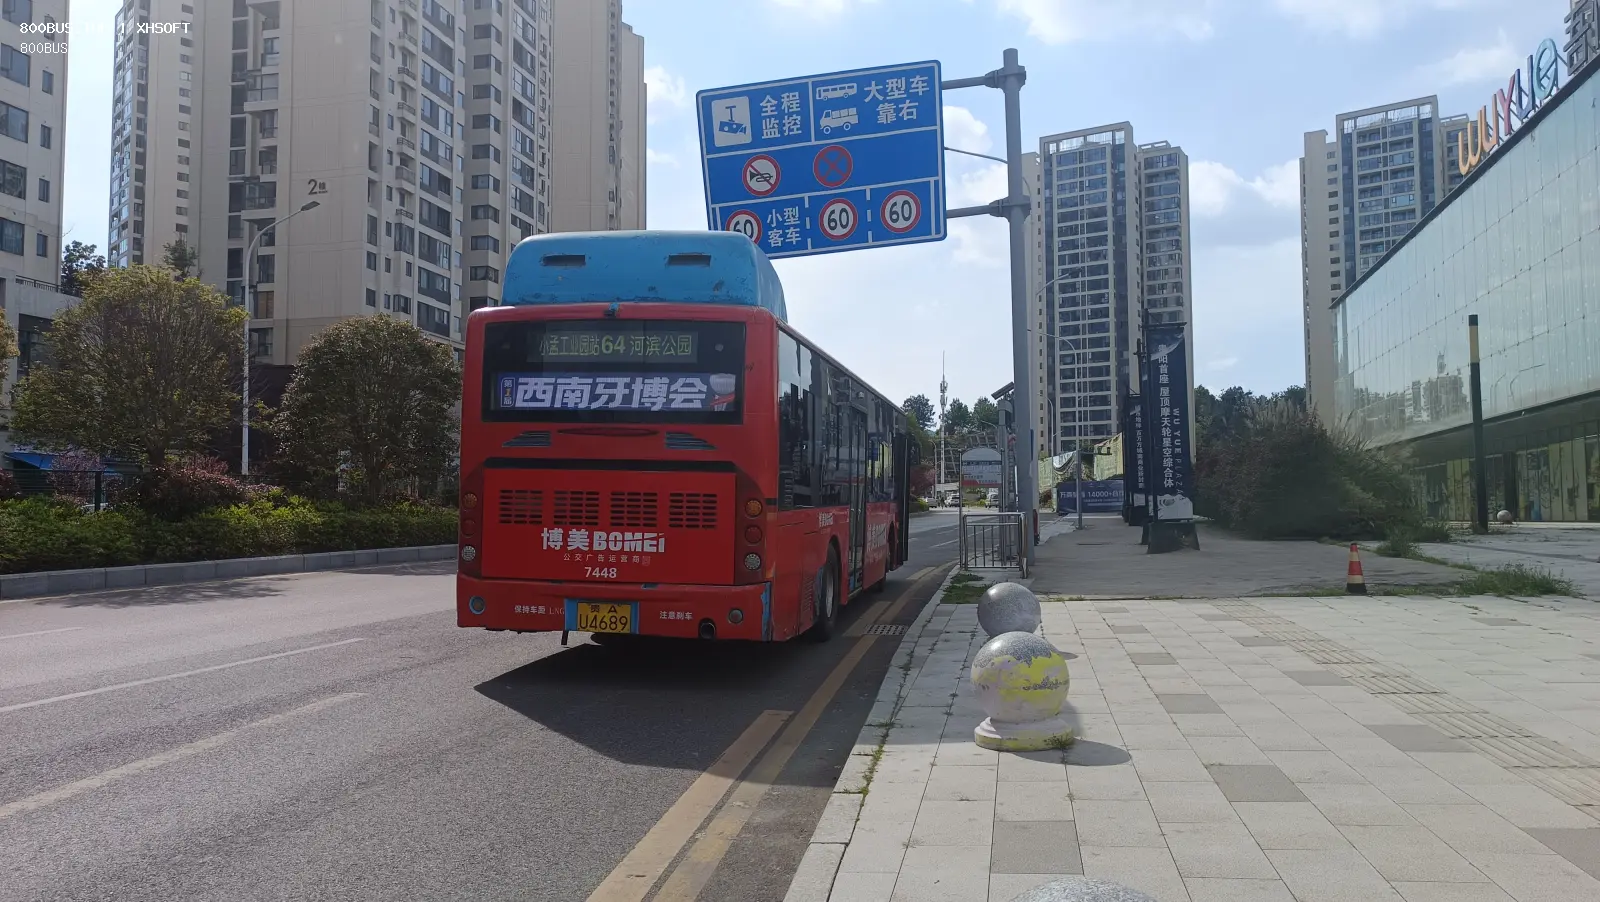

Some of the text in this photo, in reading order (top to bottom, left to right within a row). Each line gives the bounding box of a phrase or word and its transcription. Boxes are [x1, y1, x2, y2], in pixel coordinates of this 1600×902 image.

[863, 75, 930, 103] 大型车
[760, 92, 801, 116] 全程
[876, 100, 919, 124] 靠右
[761, 114, 802, 139] 监控
[767, 206, 800, 228] 小型
[827, 207, 850, 231] 60
[889, 199, 912, 224] 60
[767, 227, 802, 248] 客车
[601, 335, 626, 354] 64
[630, 335, 692, 356] 河滨公园
[515, 377, 707, 411] 西南牙博会
[563, 553, 640, 563] 公交广告运营商
[585, 566, 617, 579] 7448
[514, 605, 546, 615] 保持车距
[660, 611, 693, 620] 注意刹车
[579, 614, 629, 632] U4689
